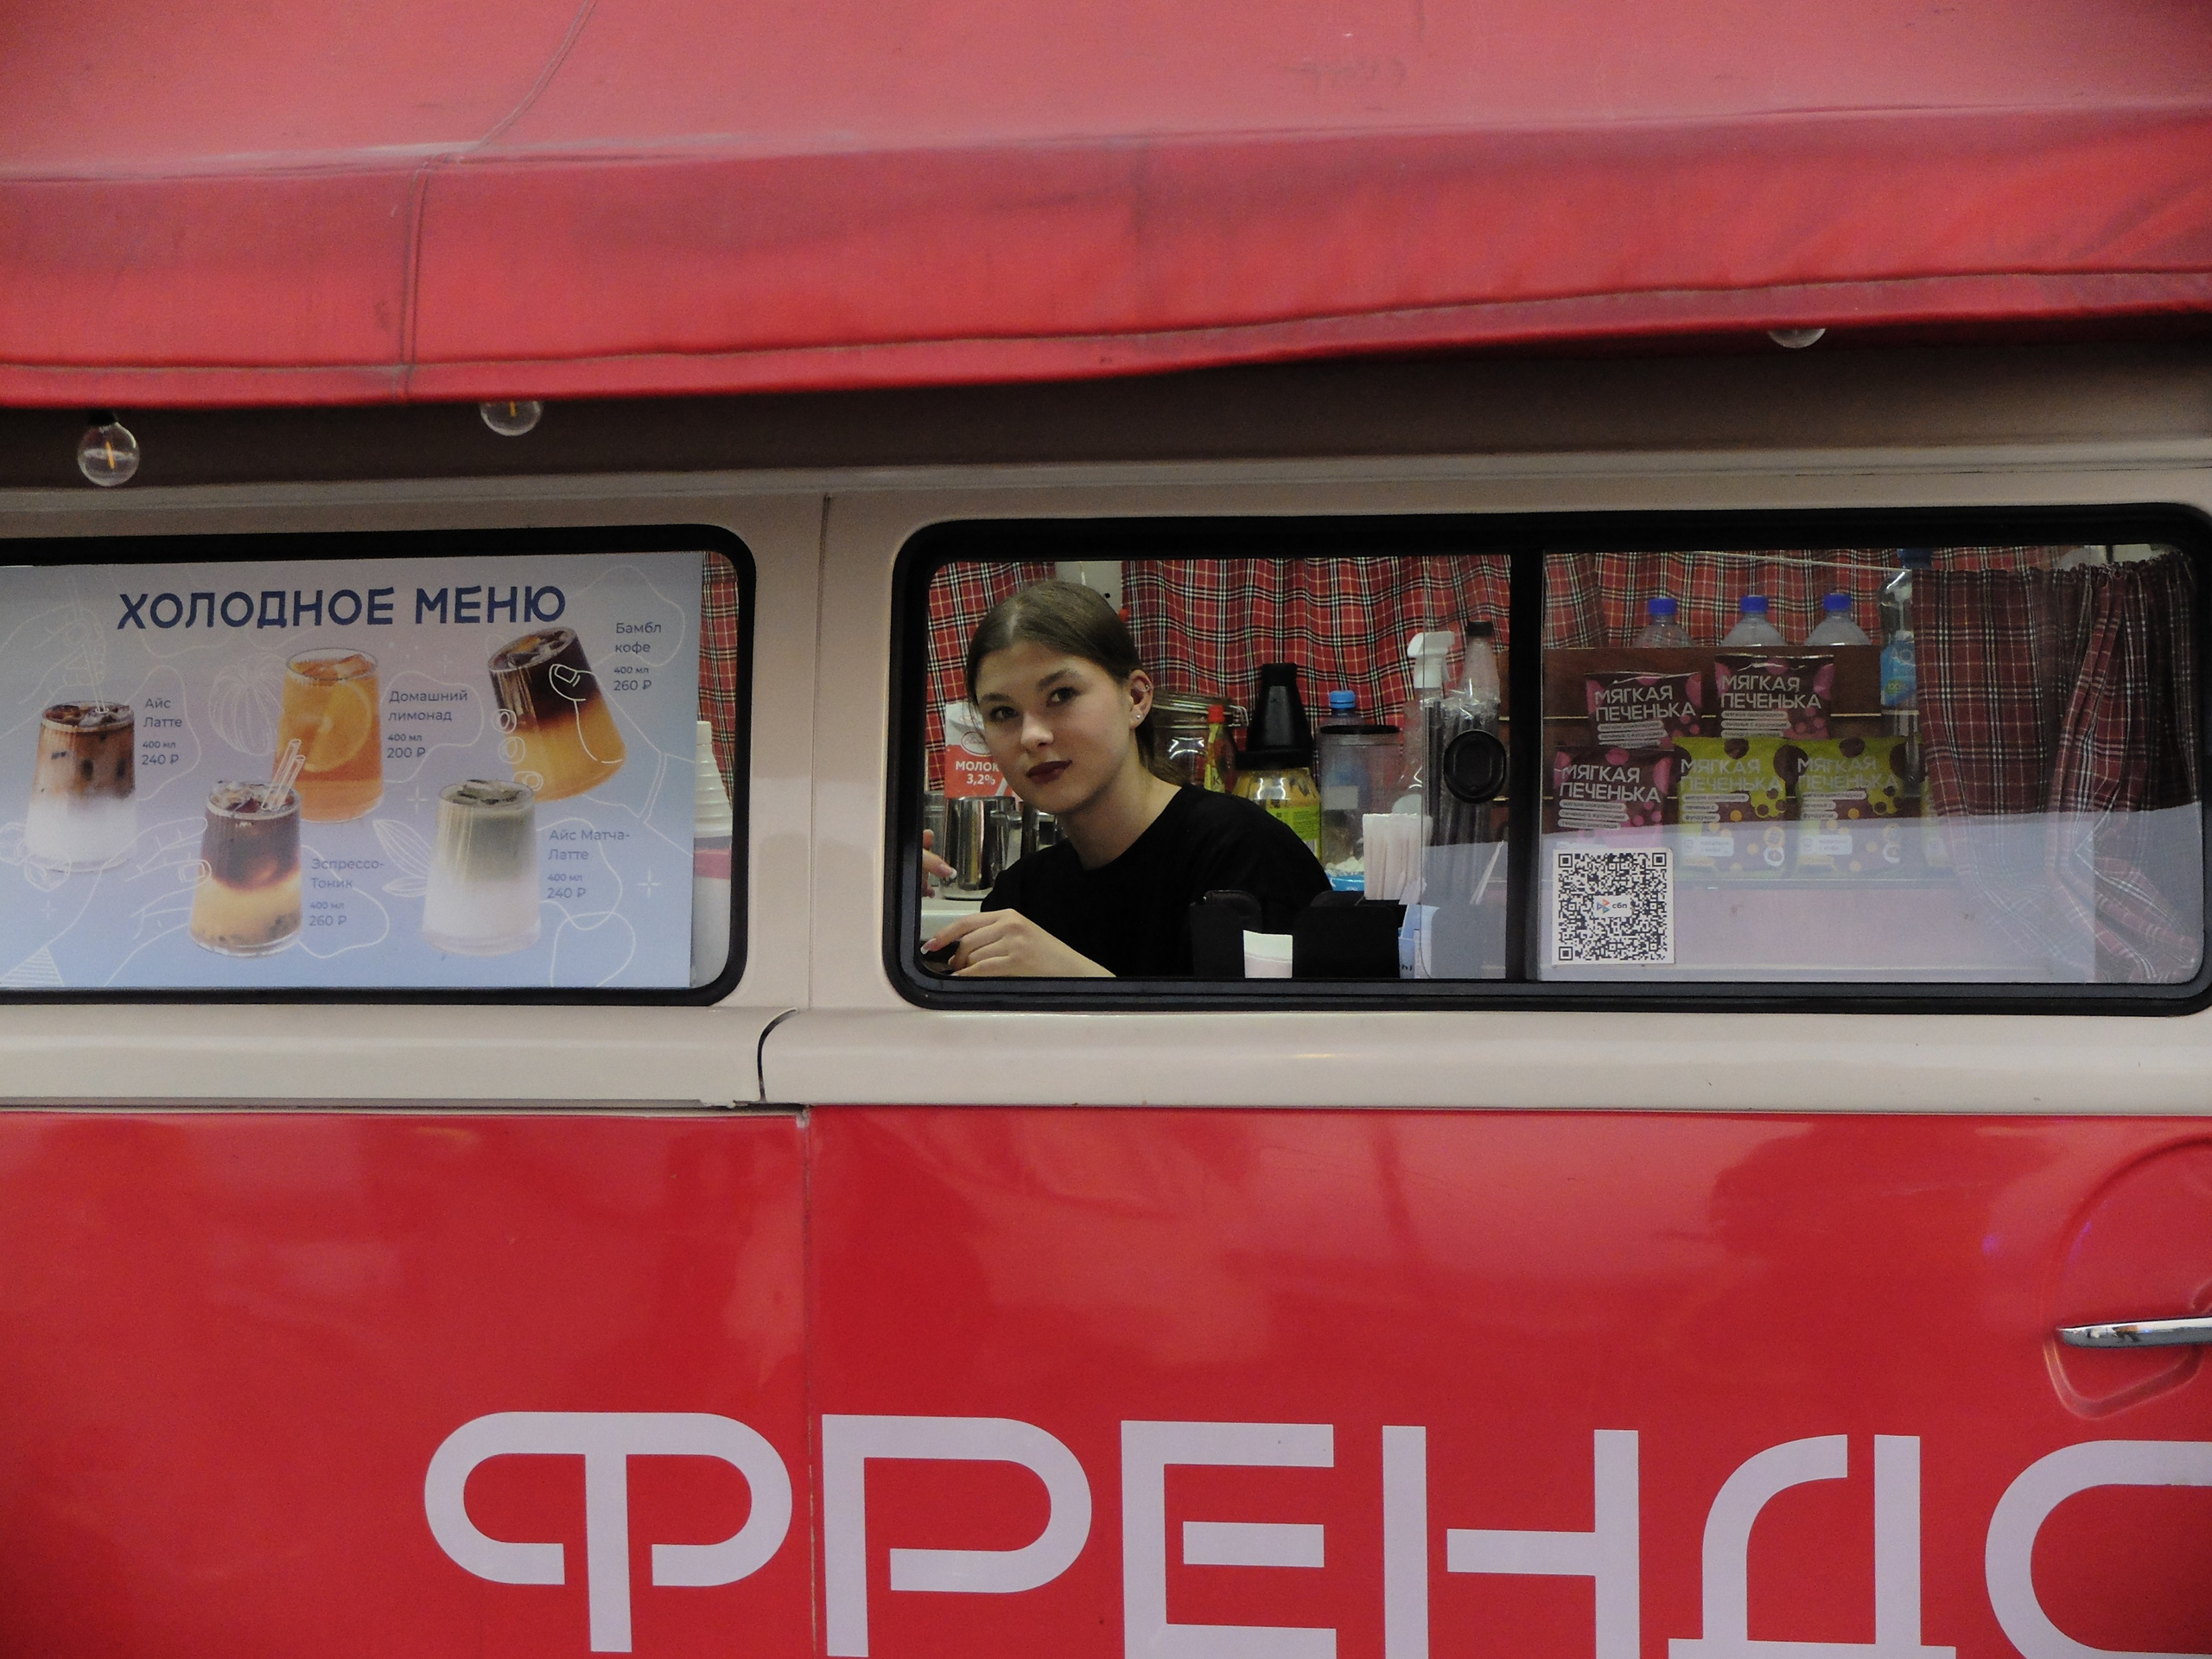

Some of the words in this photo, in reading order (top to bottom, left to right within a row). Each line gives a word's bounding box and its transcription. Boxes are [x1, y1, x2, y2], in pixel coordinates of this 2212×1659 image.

[117, 586, 394, 629] ХОЛОДНОЕ
[415, 585, 567, 624] МЕНЮ
[615, 621, 662, 633] Бамбл
[614, 641, 651, 654] кофе
[613, 680, 639, 691] 260
[1720, 675, 1801, 692] МЯГКАЯ
[388, 690, 467, 703] Домашний
[1594, 685, 1674, 705] МЯГКАЯ
[1720, 692, 1822, 709] ПЕЧЕНЬКА
[144, 697, 172, 709] Айс
[388, 711, 453, 721] лимонад
[1595, 702, 1697, 722] ПЕЧЕНЬКА
[143, 716, 183, 728] Латте
[387, 733, 407, 741] 400
[386, 747, 412, 759] 200
[141, 754, 166, 766] 240
[955, 760, 1001, 772] МОЛОК
[1797, 757, 1877, 773] МЯГКАЯ
[1681, 759, 1761, 774] МЯГКАЯ
[966, 773, 996, 785] 3,2%
[1560, 764, 1640, 783] МЯГКАЯ
[1680, 775, 1783, 791] ПЕЧЕНЬКА
[1797, 774, 1898, 791] ПЕЧЕНЬКА
[1559, 781, 1662, 803] ПЕЧЕНЬКА
[549, 829, 577, 841] Айс
[581, 830, 630, 841] Матча-
[548, 849, 589, 860] Латте
[310, 858, 385, 871] Эспрессо-
[310, 877, 353, 888] Тоник
[547, 873, 567, 881] 400
[547, 887, 572, 899] 240
[309, 901, 328, 910] 400
[308, 915, 334, 926] 260
